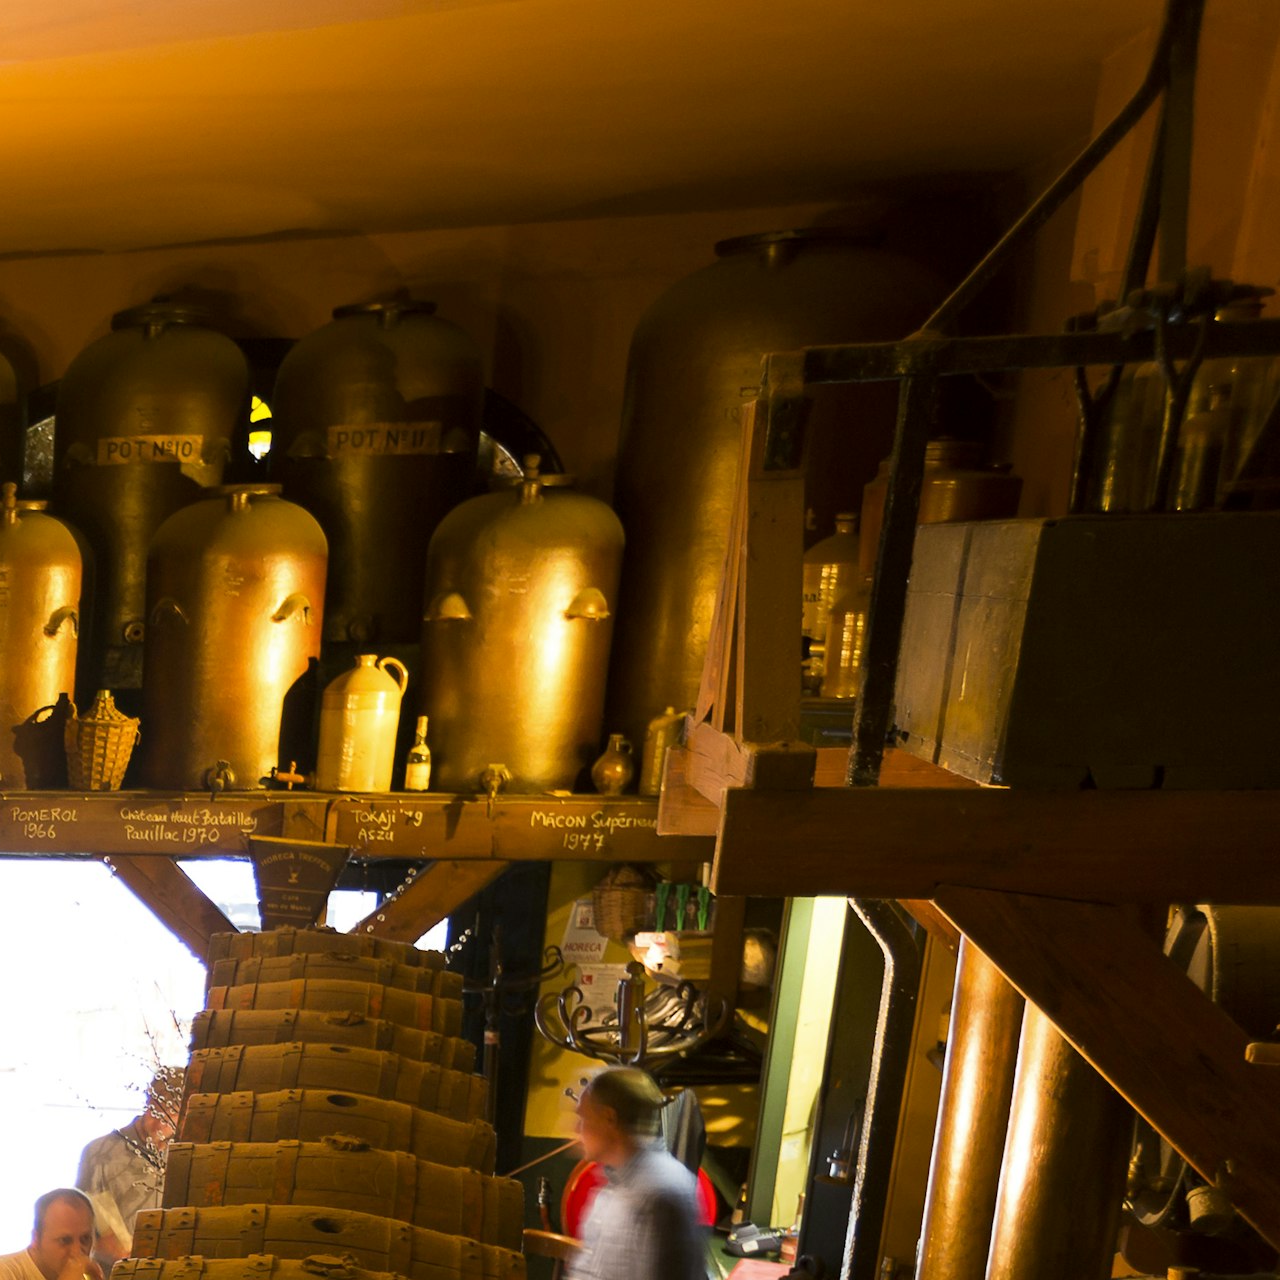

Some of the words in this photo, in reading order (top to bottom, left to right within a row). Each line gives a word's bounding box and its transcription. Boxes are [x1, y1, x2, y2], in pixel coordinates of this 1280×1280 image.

[336, 429, 377, 450] POT
[106, 440, 147, 460] POT
[10, 807, 79, 824] POMEROL
[23, 823, 56, 839] 1966
[125, 824, 179, 842] Pauillac
[181, 825, 221, 844] 1970
[562, 831, 606, 852] 1977
